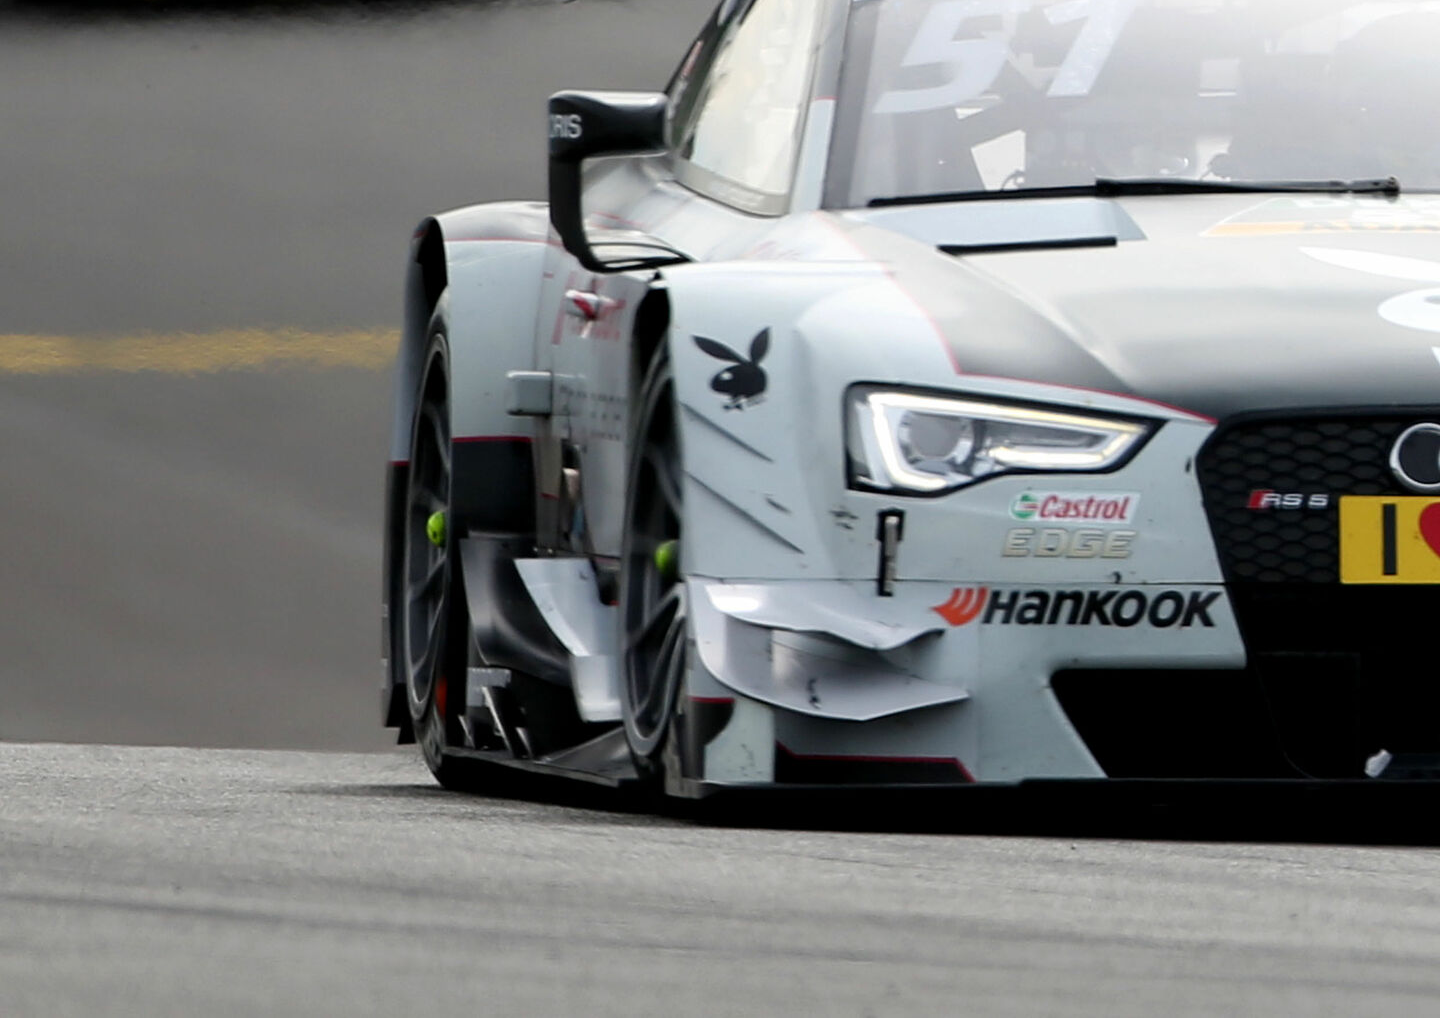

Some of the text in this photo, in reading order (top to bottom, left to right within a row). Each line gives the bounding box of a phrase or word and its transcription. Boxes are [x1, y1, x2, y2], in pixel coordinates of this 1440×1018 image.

[1037, 494, 1131, 521] Castrol
[1260, 492, 1304, 509] RS
[1001, 528, 1136, 559] EDGE
